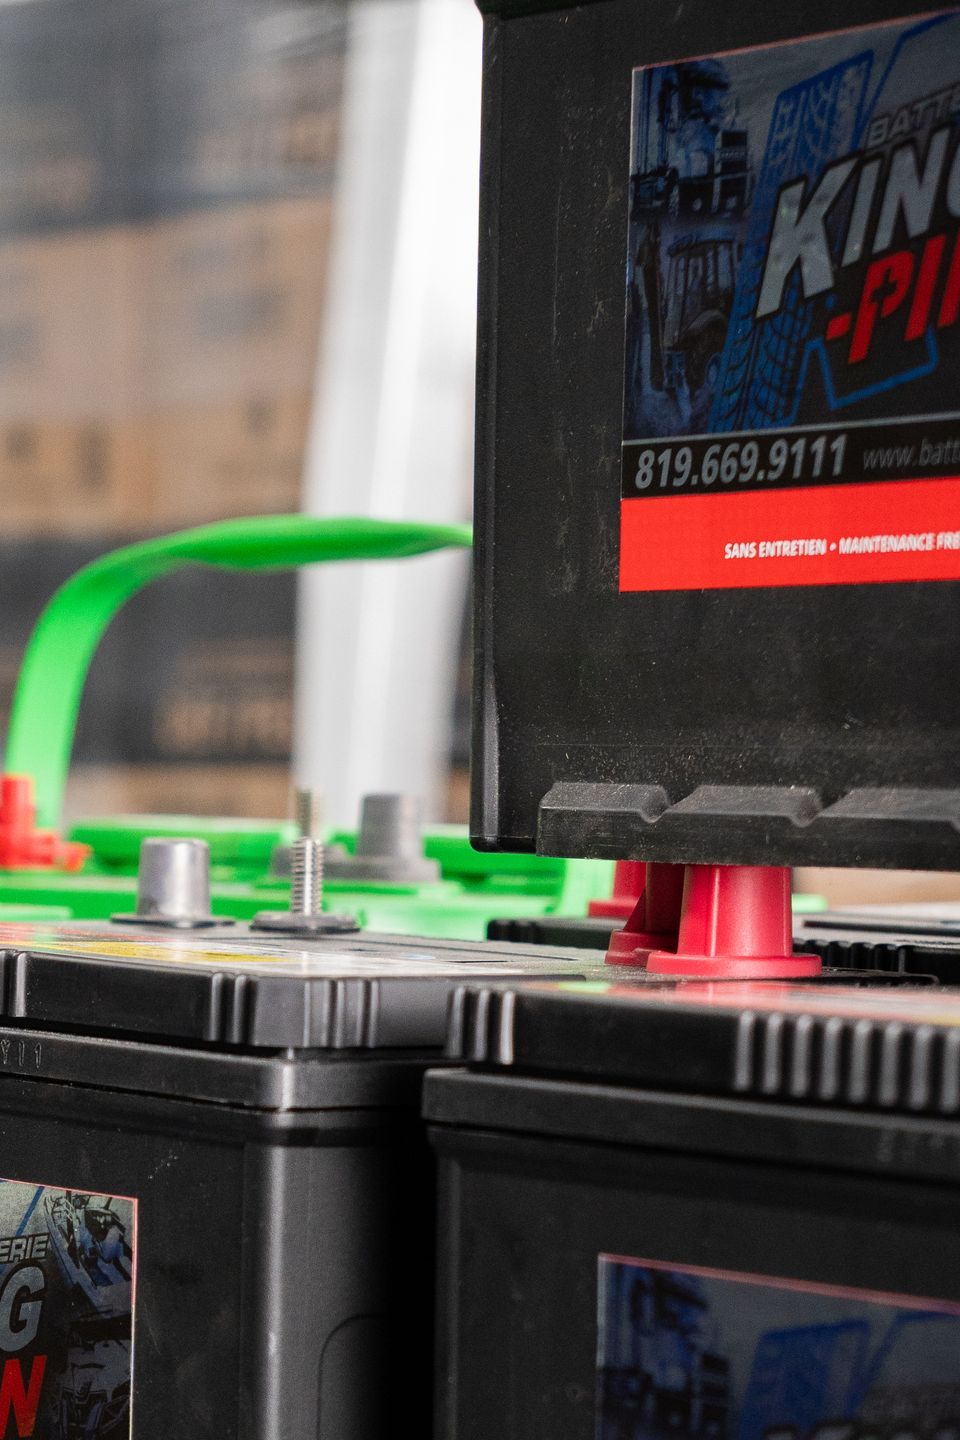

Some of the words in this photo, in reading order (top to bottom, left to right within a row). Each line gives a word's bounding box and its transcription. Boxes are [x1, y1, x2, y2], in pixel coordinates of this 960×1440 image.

[635, 434, 847, 490] 819.669.9111
[724, 542, 756, 560] SANS
[758, 538, 827, 558] ENTRETIEN
[839, 533, 936, 556] MAINTENANCE
